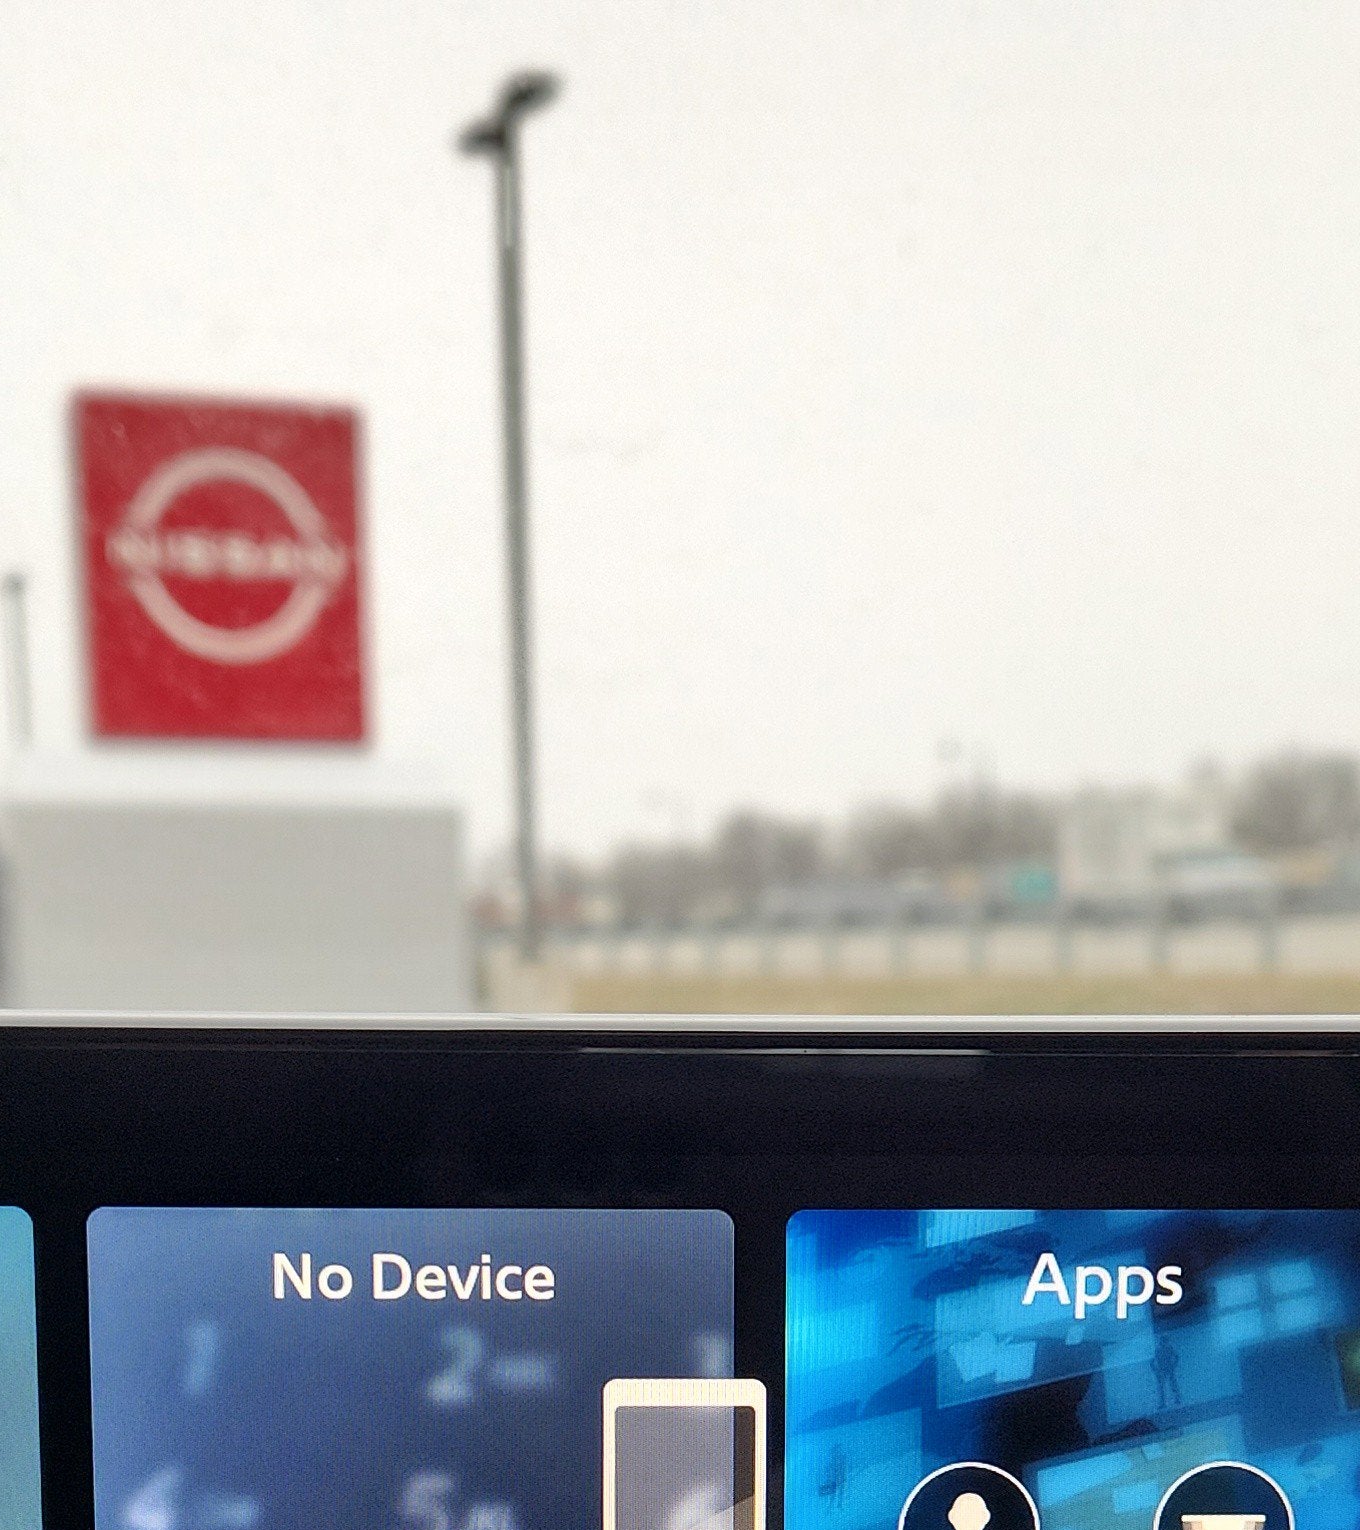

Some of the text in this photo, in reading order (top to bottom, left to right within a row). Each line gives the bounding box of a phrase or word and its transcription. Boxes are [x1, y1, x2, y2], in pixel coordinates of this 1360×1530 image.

[273, 1253, 555, 1300] No Device
[1022, 1253, 1183, 1319] Apps
